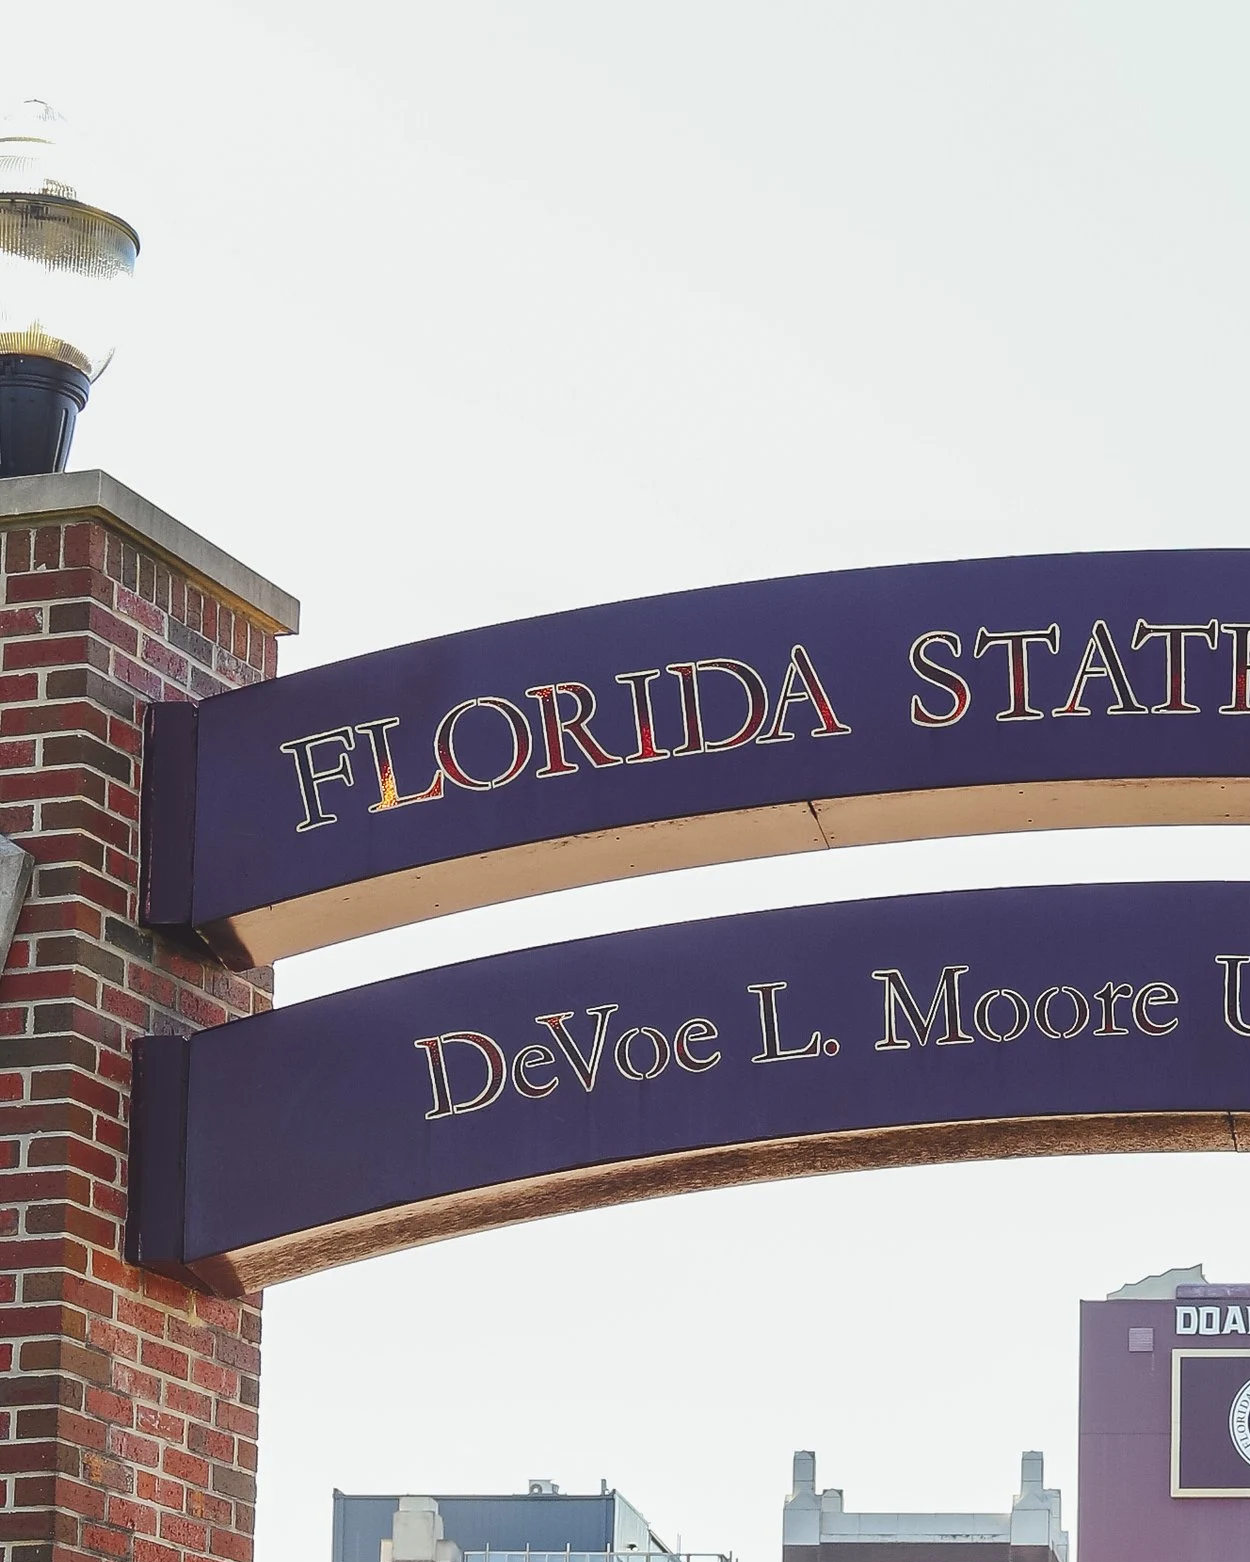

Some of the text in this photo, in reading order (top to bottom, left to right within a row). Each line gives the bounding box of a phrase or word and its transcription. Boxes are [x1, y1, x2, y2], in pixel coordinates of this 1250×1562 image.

[279, 643, 852, 833] FLORIDA
[413, 1003, 722, 1120] DeVoe
[746, 981, 841, 1064] L.
[871, 965, 1179, 1051] Moore
